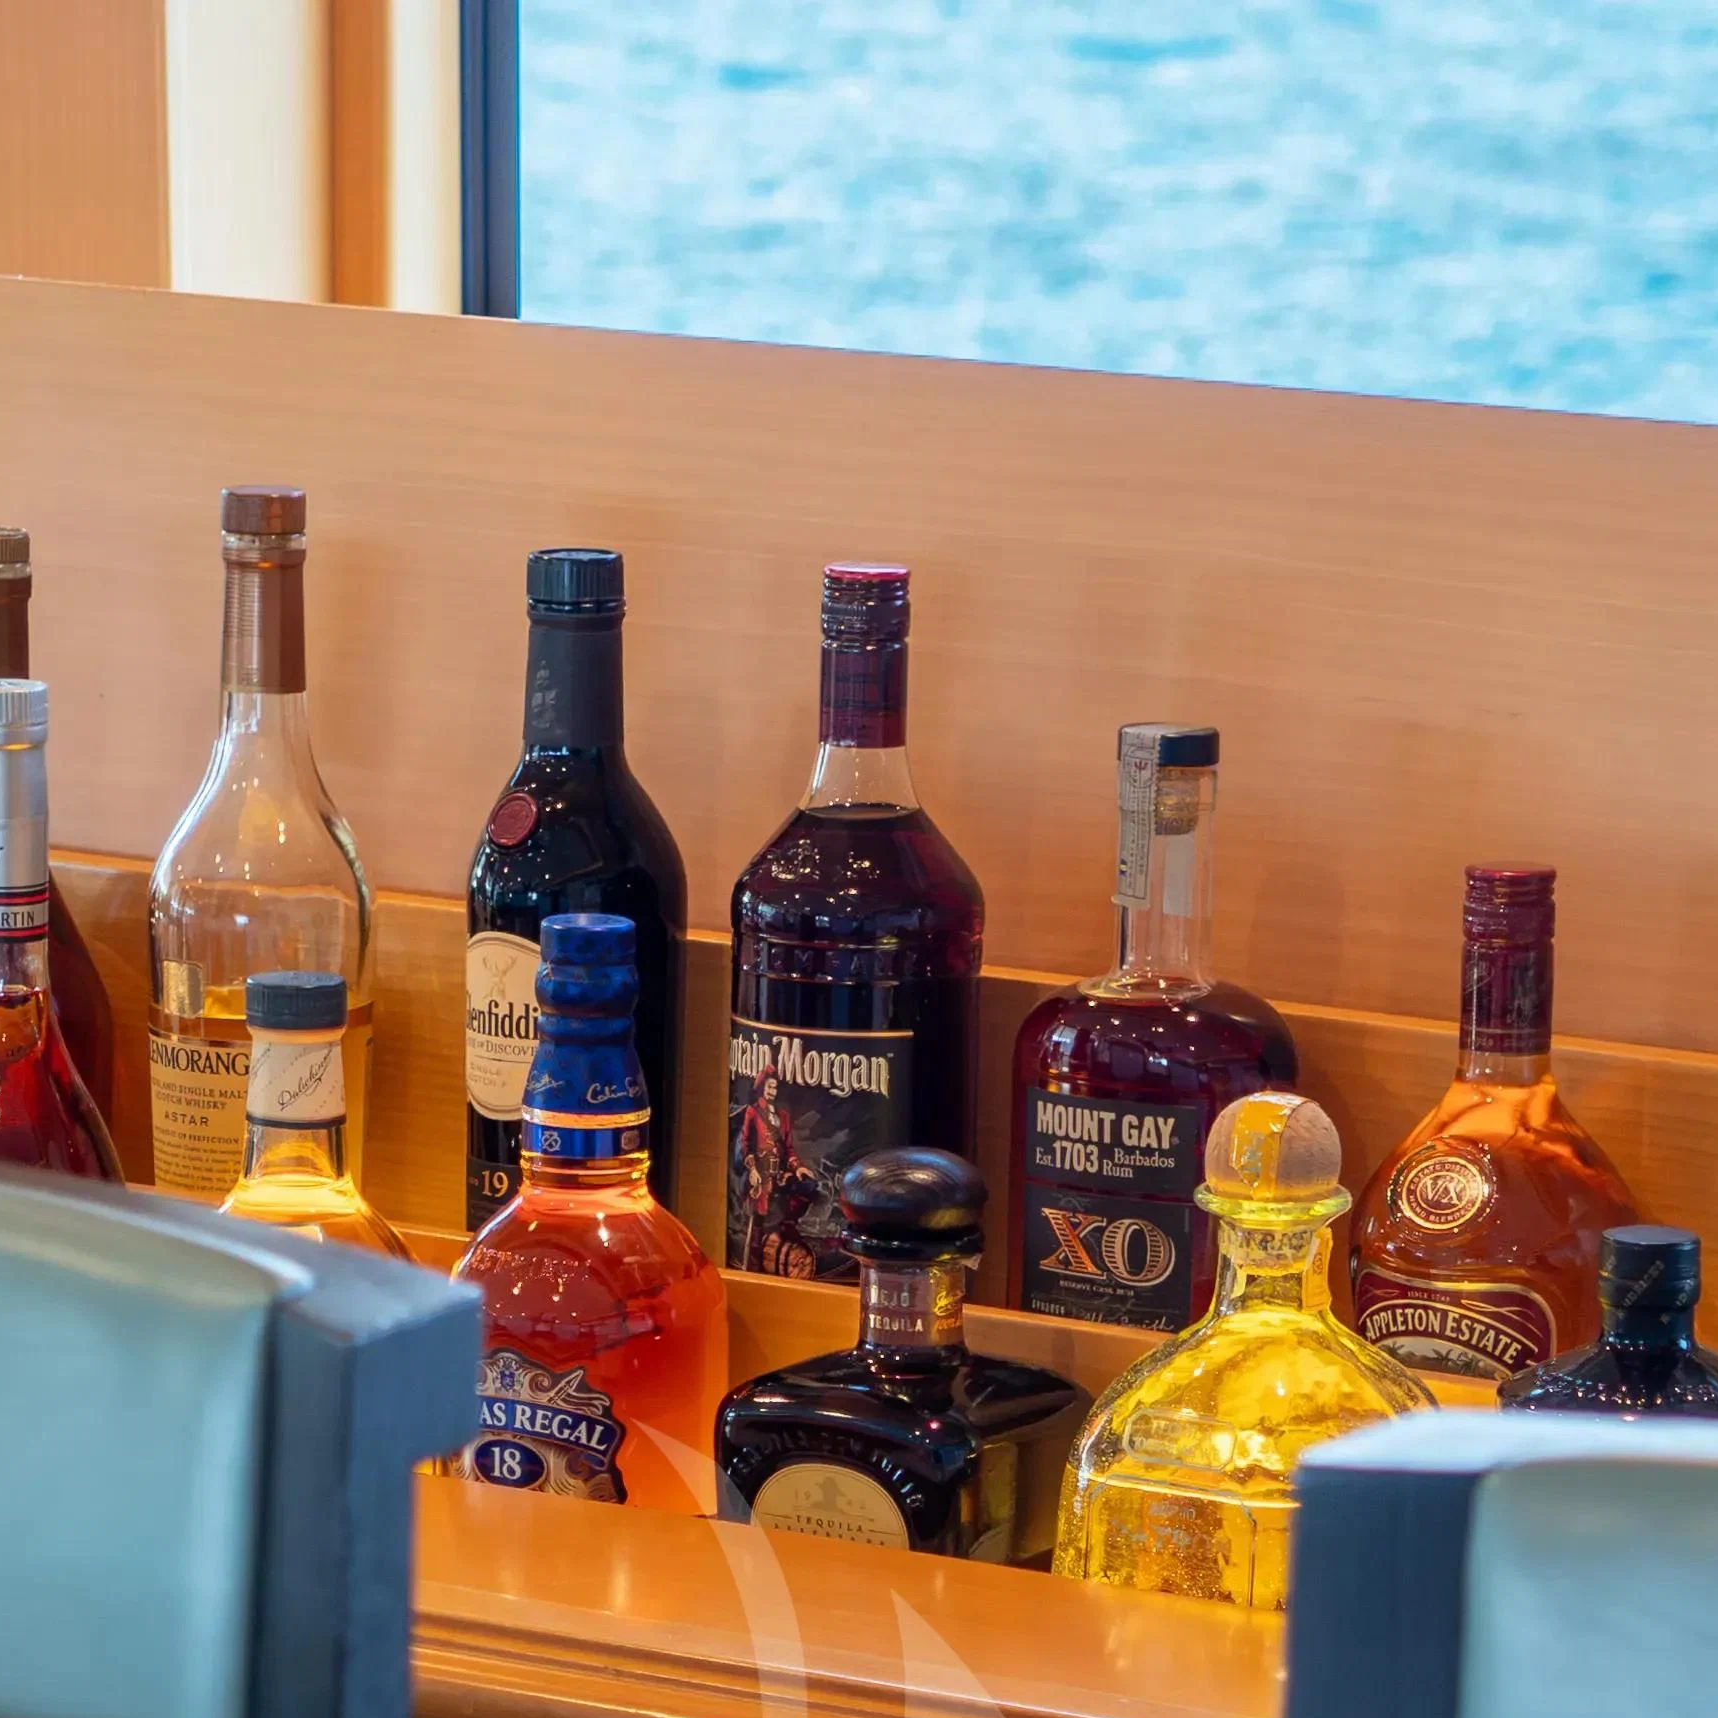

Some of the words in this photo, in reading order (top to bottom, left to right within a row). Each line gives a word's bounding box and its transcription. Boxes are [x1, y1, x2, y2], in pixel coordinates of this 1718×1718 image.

[466, 990, 539, 1040] lenfiddi
[773, 1035, 890, 1099] Morgan
[164, 1111, 210, 1127] ASTAR
[1037, 1100, 1116, 1144] MOUNT
[1122, 1114, 1175, 1149] GAY
[1053, 1140, 1099, 1173] 1703
[1114, 1147, 1175, 1168] Barbados
[1103, 1159, 1133, 1178] Rum
[481, 1170, 509, 1197] 19
[1038, 1207, 1176, 1287] XO
[868, 1313, 924, 1332] TEQUILA
[1365, 1308, 1442, 1341] APPLETON
[1444, 1311, 1523, 1364] ESTATE
[513, 1404, 609, 1451] REGAL
[490, 1447, 522, 1480] 18
[796, 1515, 865, 1534] TEQUILA
